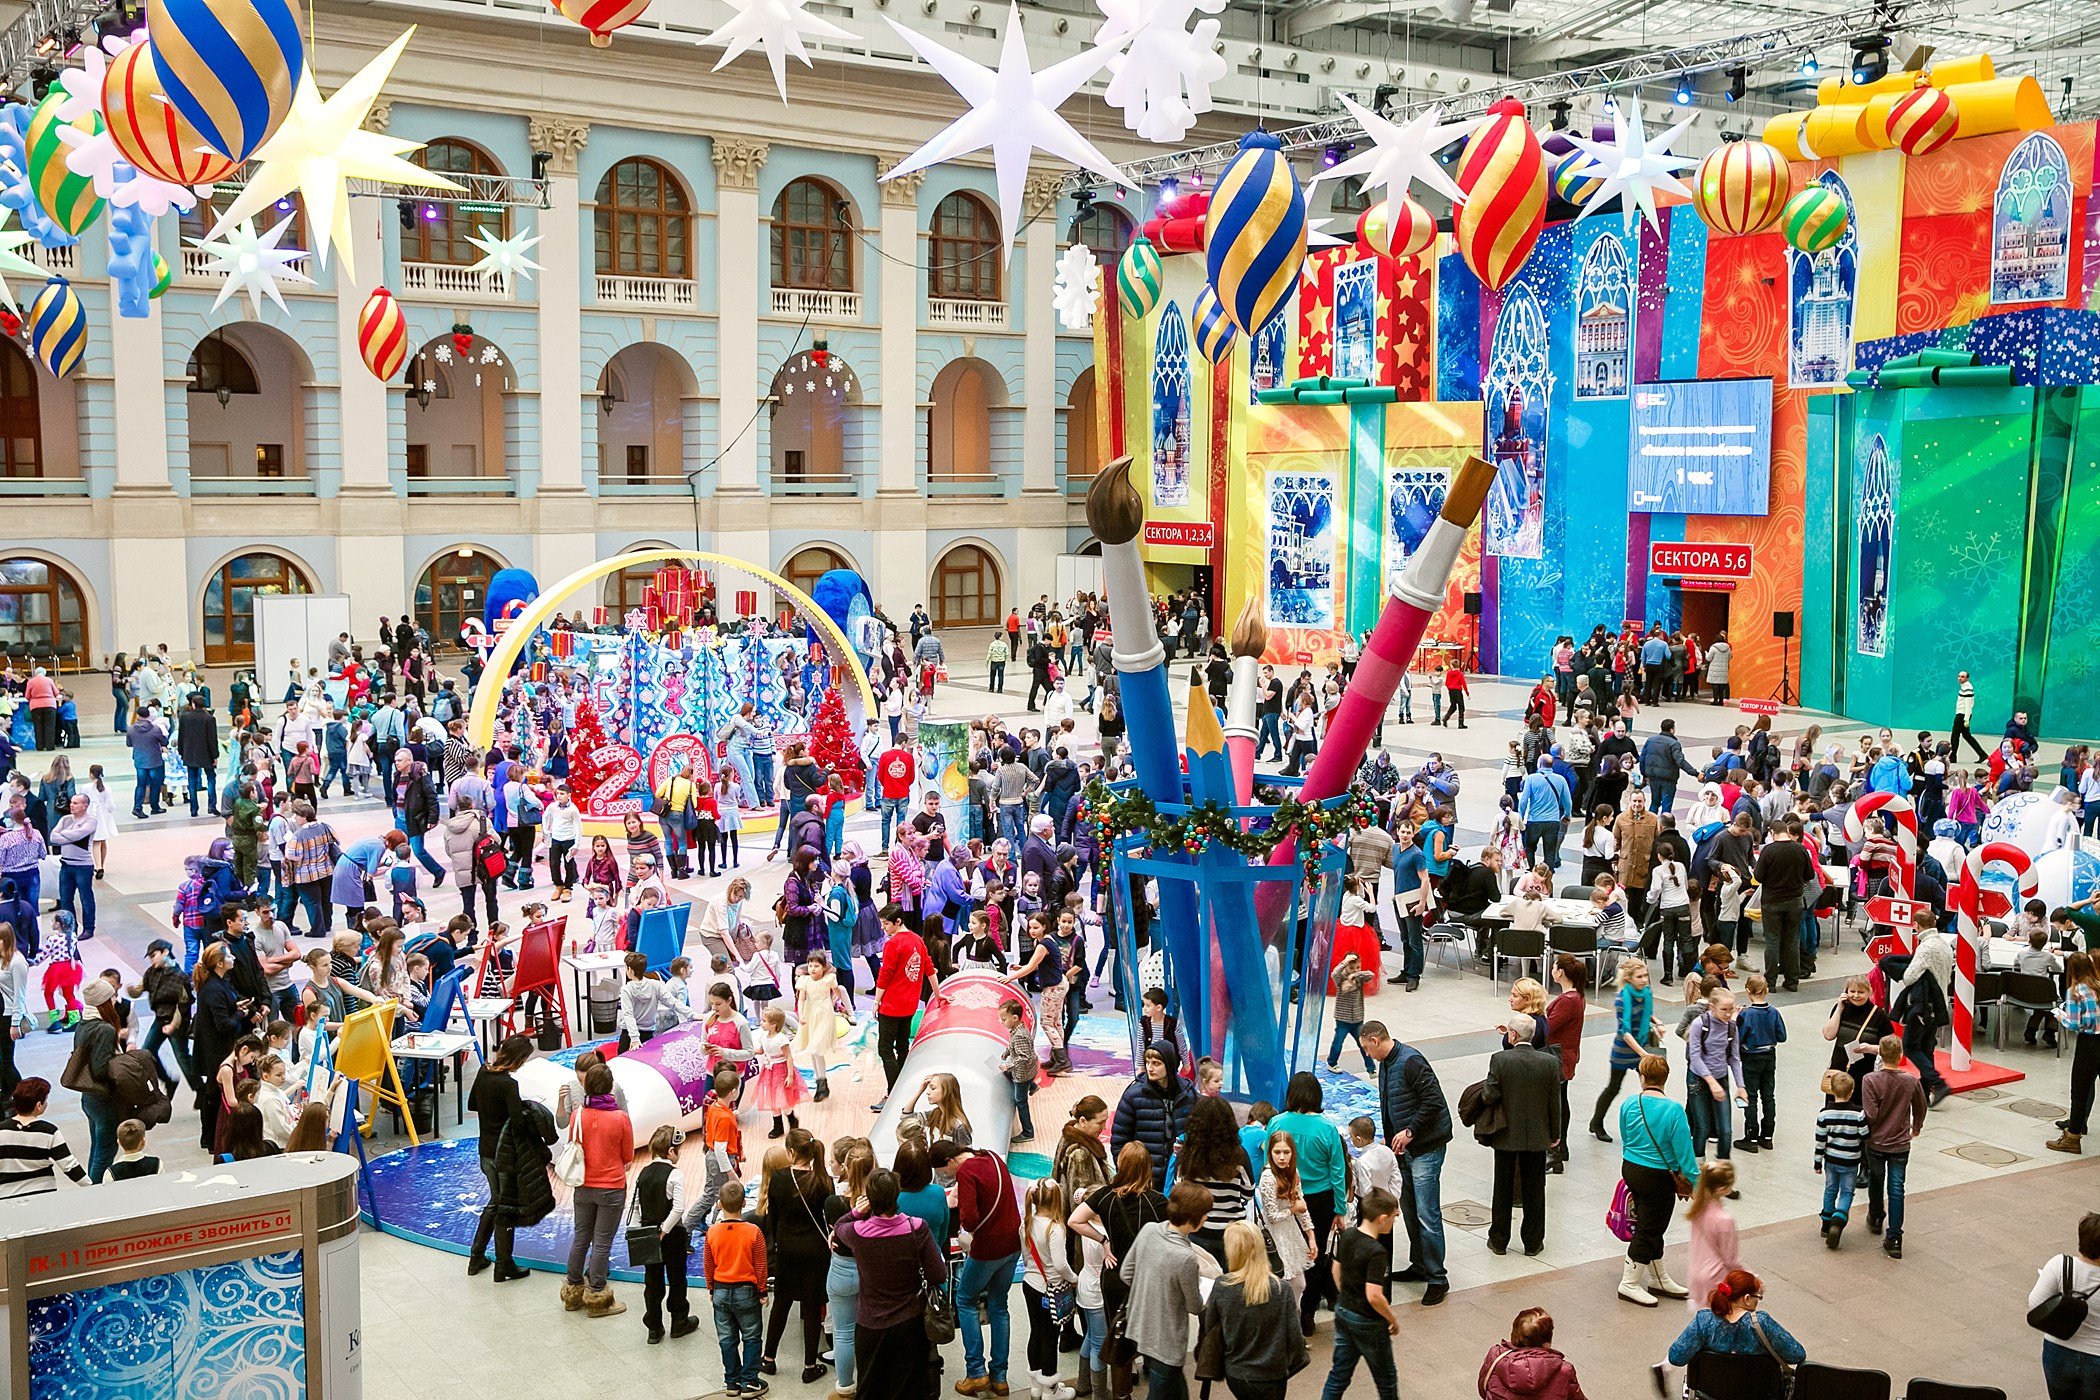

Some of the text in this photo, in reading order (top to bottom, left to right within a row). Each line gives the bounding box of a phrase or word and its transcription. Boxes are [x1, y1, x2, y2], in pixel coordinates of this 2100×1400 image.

[1145, 526, 1212, 543] СЕКТОРА 1,2,3,4
[1654, 550, 1747, 571] СЕКТОРА 5,6
[1739, 702, 1759, 710] СЕКТОР
[1878, 944, 1893, 955] ВЫ
[85, 1215, 291, 1260] ПРИ ПОЖАРЕ ЗВОНИТЬ 01
